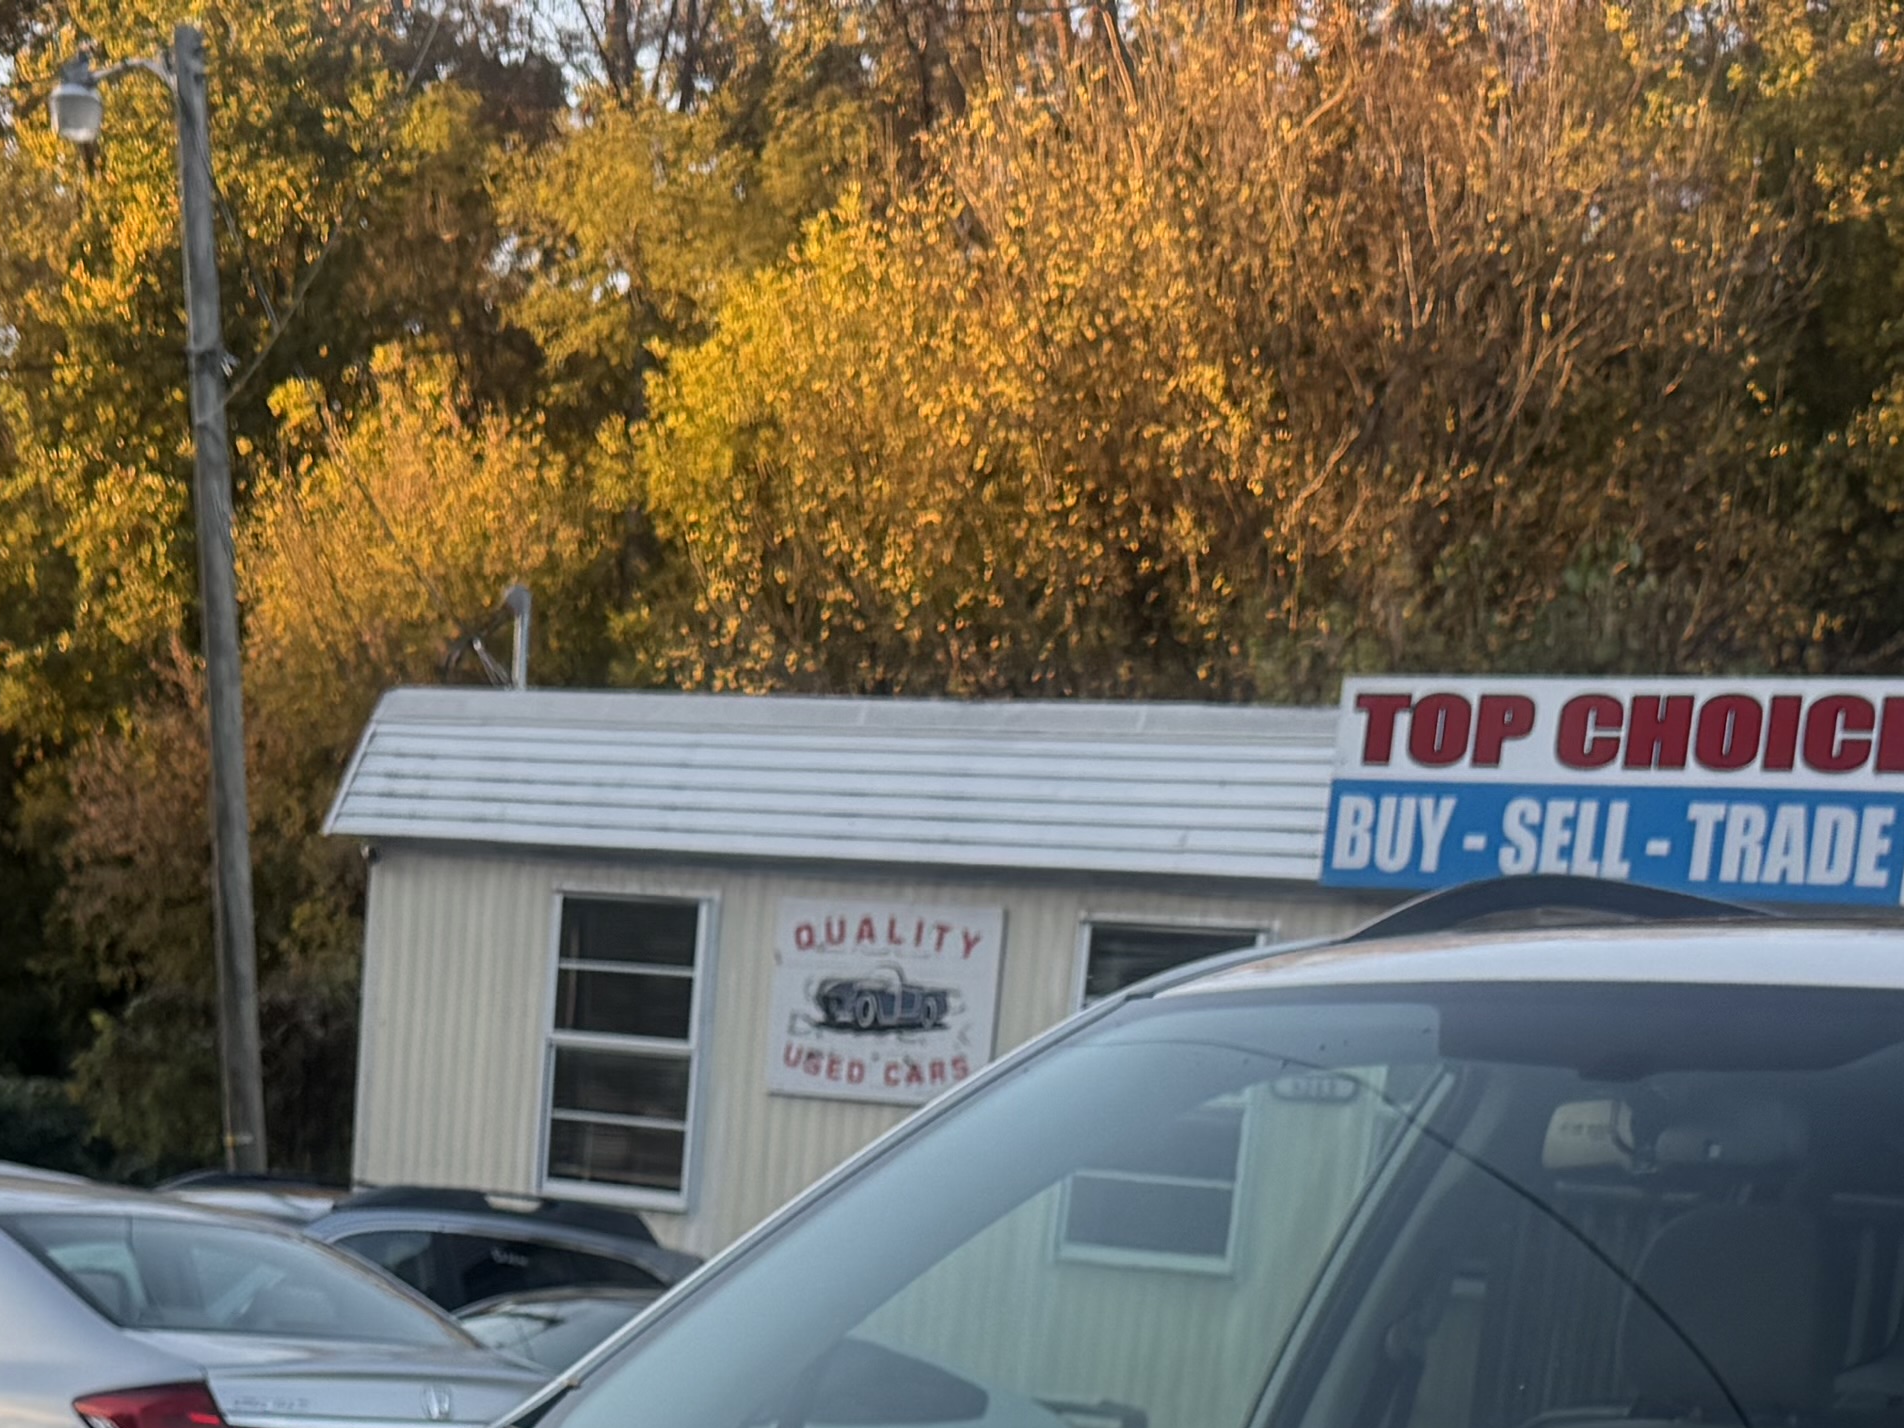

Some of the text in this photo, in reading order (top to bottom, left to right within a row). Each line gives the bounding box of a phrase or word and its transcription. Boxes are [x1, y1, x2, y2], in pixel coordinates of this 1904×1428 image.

[1356, 692, 1536, 768] TOP
[1331, 794, 1457, 874] BUY
[1498, 797, 1631, 880] SELL
[1687, 803, 1896, 888] TRADE
[794, 914, 982, 960] QUALITY
[783, 1041, 971, 1087] USED CARS
